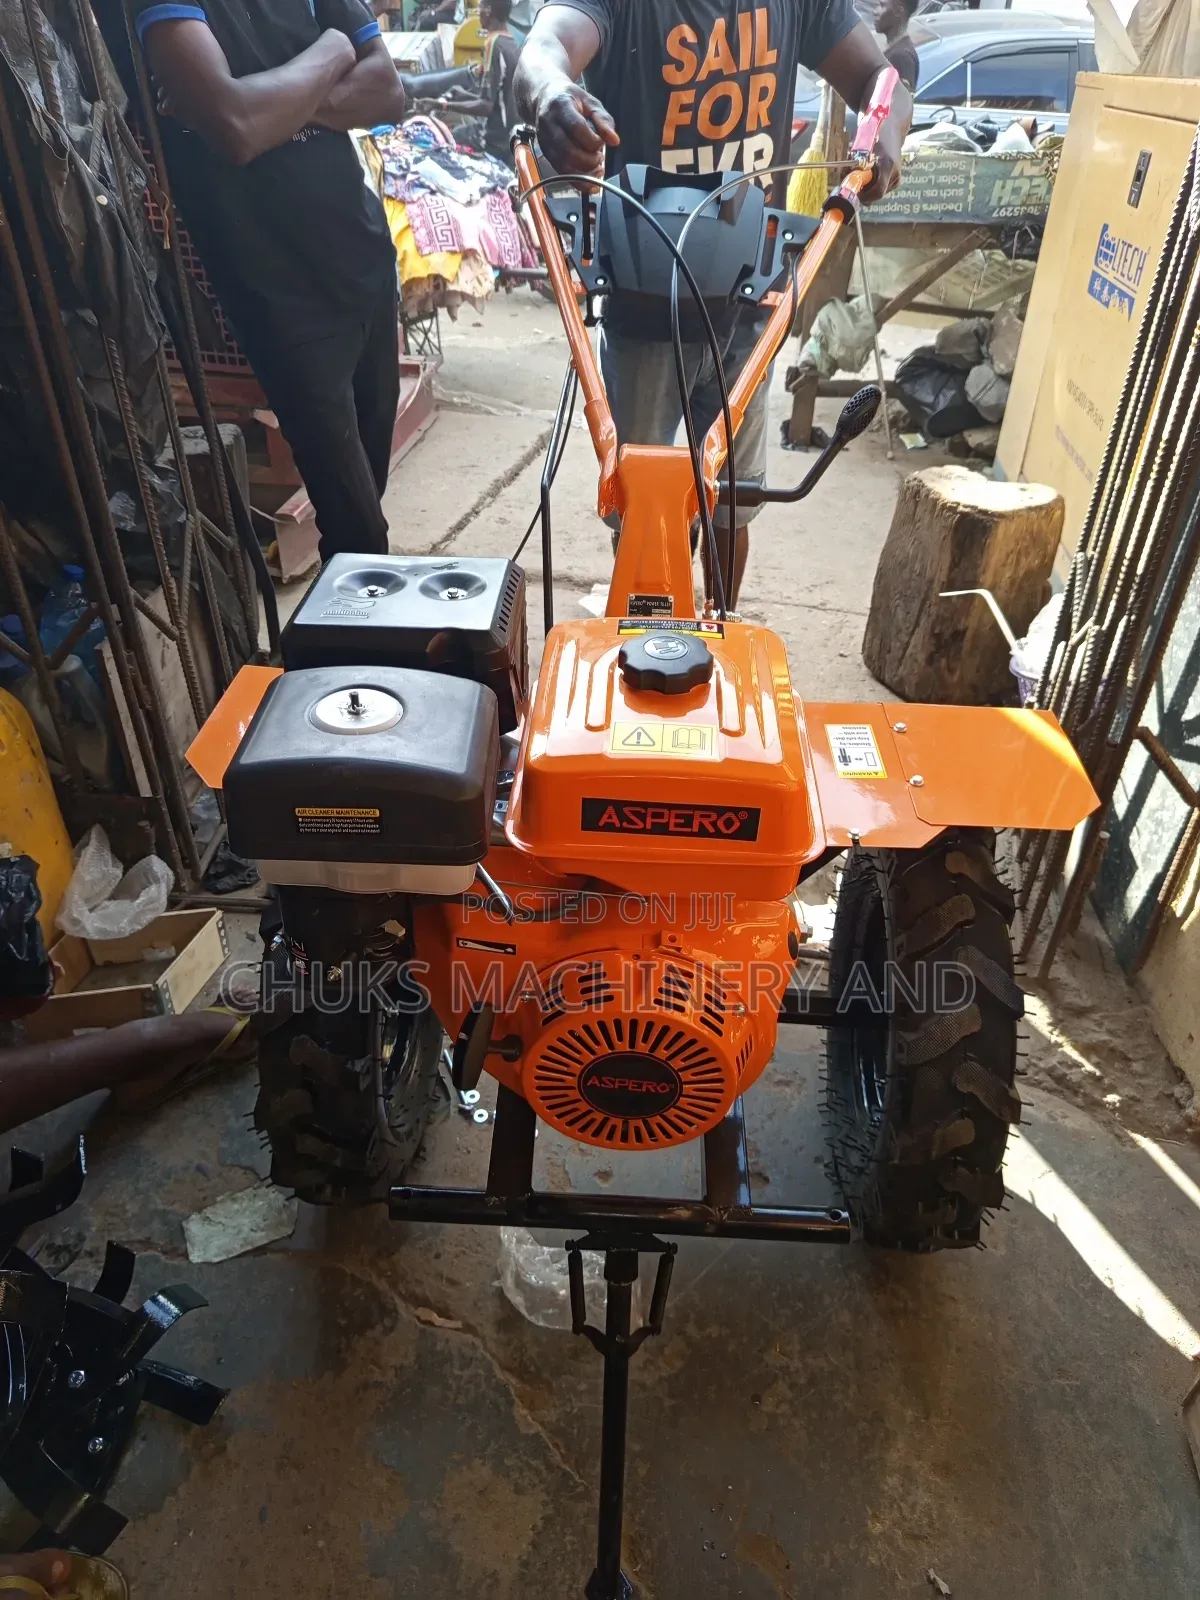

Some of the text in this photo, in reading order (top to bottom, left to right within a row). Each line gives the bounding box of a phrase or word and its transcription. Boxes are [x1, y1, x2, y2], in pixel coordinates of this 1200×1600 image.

[662, 8, 777, 85] SAIL
[661, 72, 776, 145] FOR
[936, 174, 965, 185] Solar
[940, 188, 964, 200] such
[862, 202, 911, 215] Suppliers
[922, 202, 963, 213] Dealers
